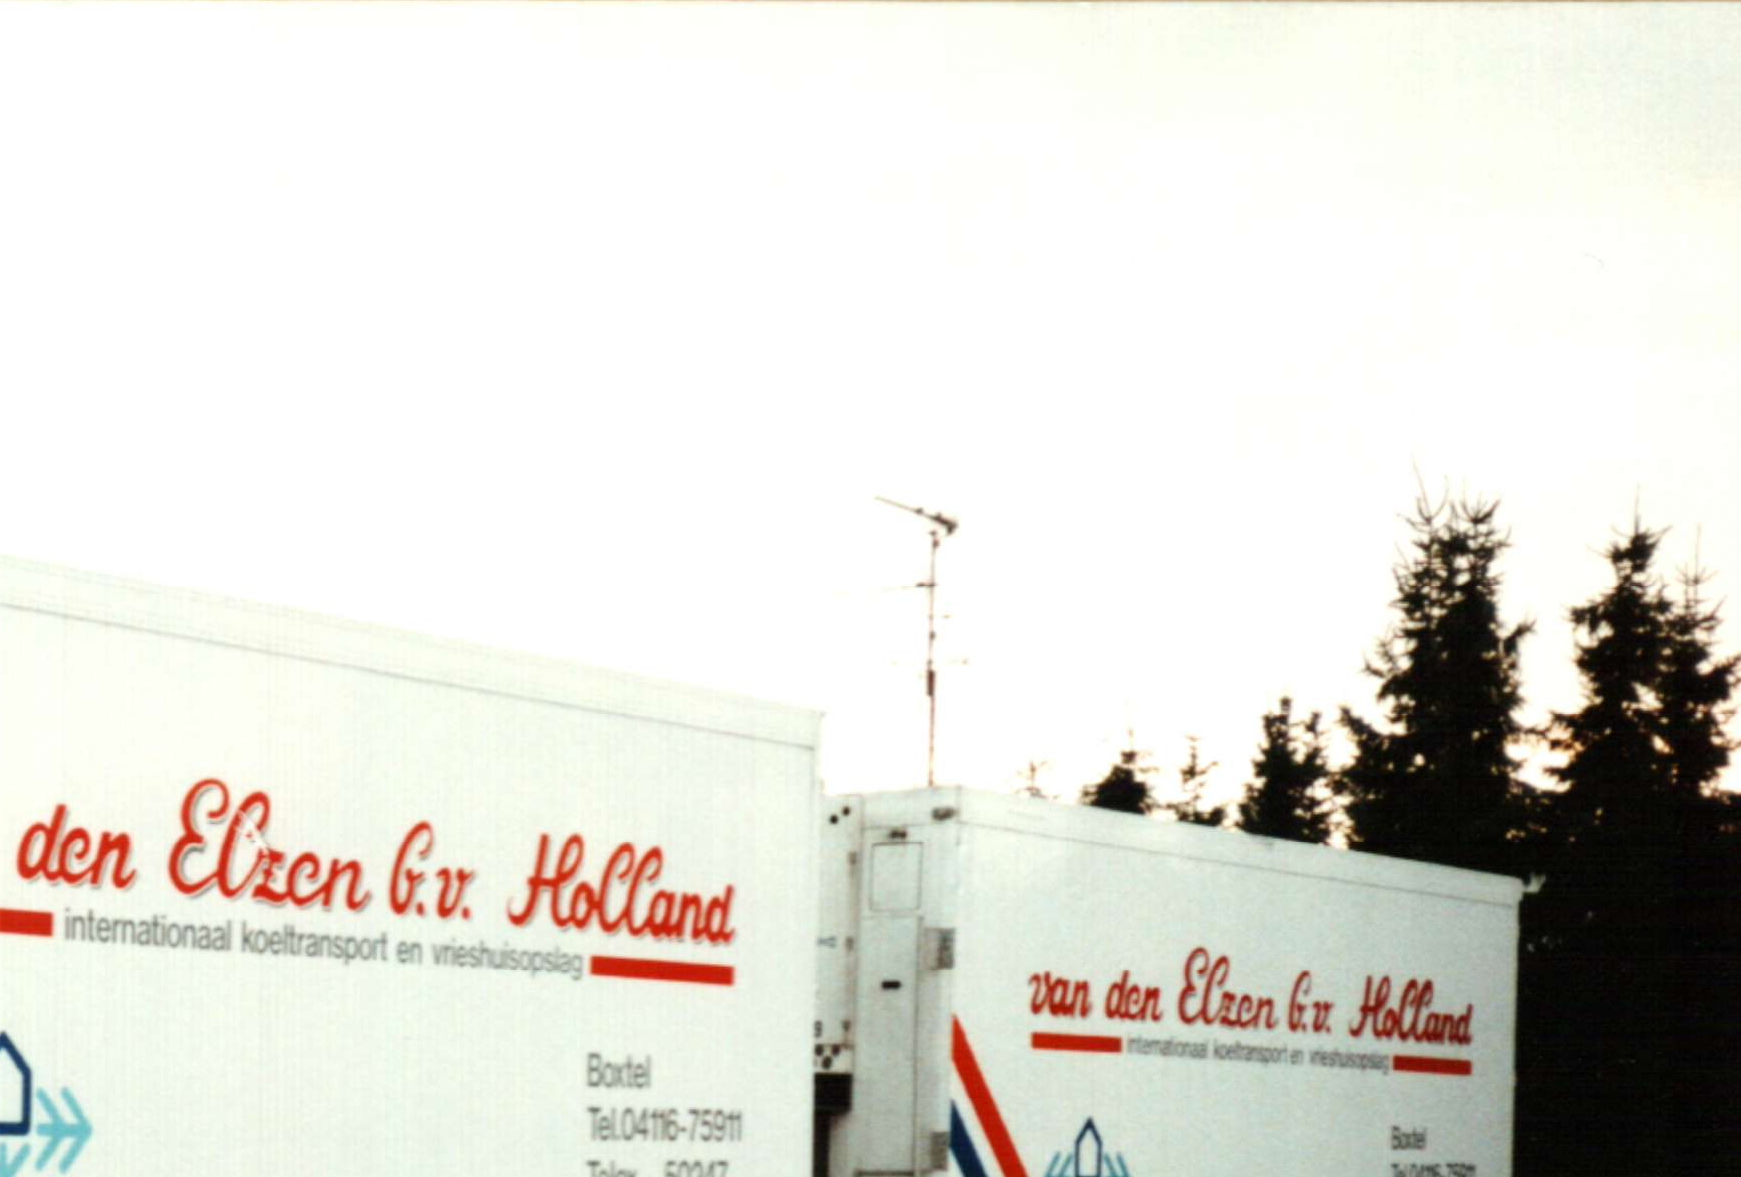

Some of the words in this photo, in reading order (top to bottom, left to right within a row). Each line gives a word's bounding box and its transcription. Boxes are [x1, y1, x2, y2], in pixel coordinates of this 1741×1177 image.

[16, 803, 137, 890] den
[168, 778, 371, 913] Elzen
[506, 833, 736, 944] Holland
[64, 907, 231, 952] internationaal
[241, 921, 388, 966] koeltransport
[396, 940, 423, 965] en
[431, 938, 584, 980] vrieshuisopslag
[1028, 970, 1093, 1019] van
[1105, 969, 1164, 1023] den
[1178, 946, 1279, 1030] Elzen
[1349, 974, 1475, 1046] Holland
[586, 1052, 652, 1089] Boxtel
